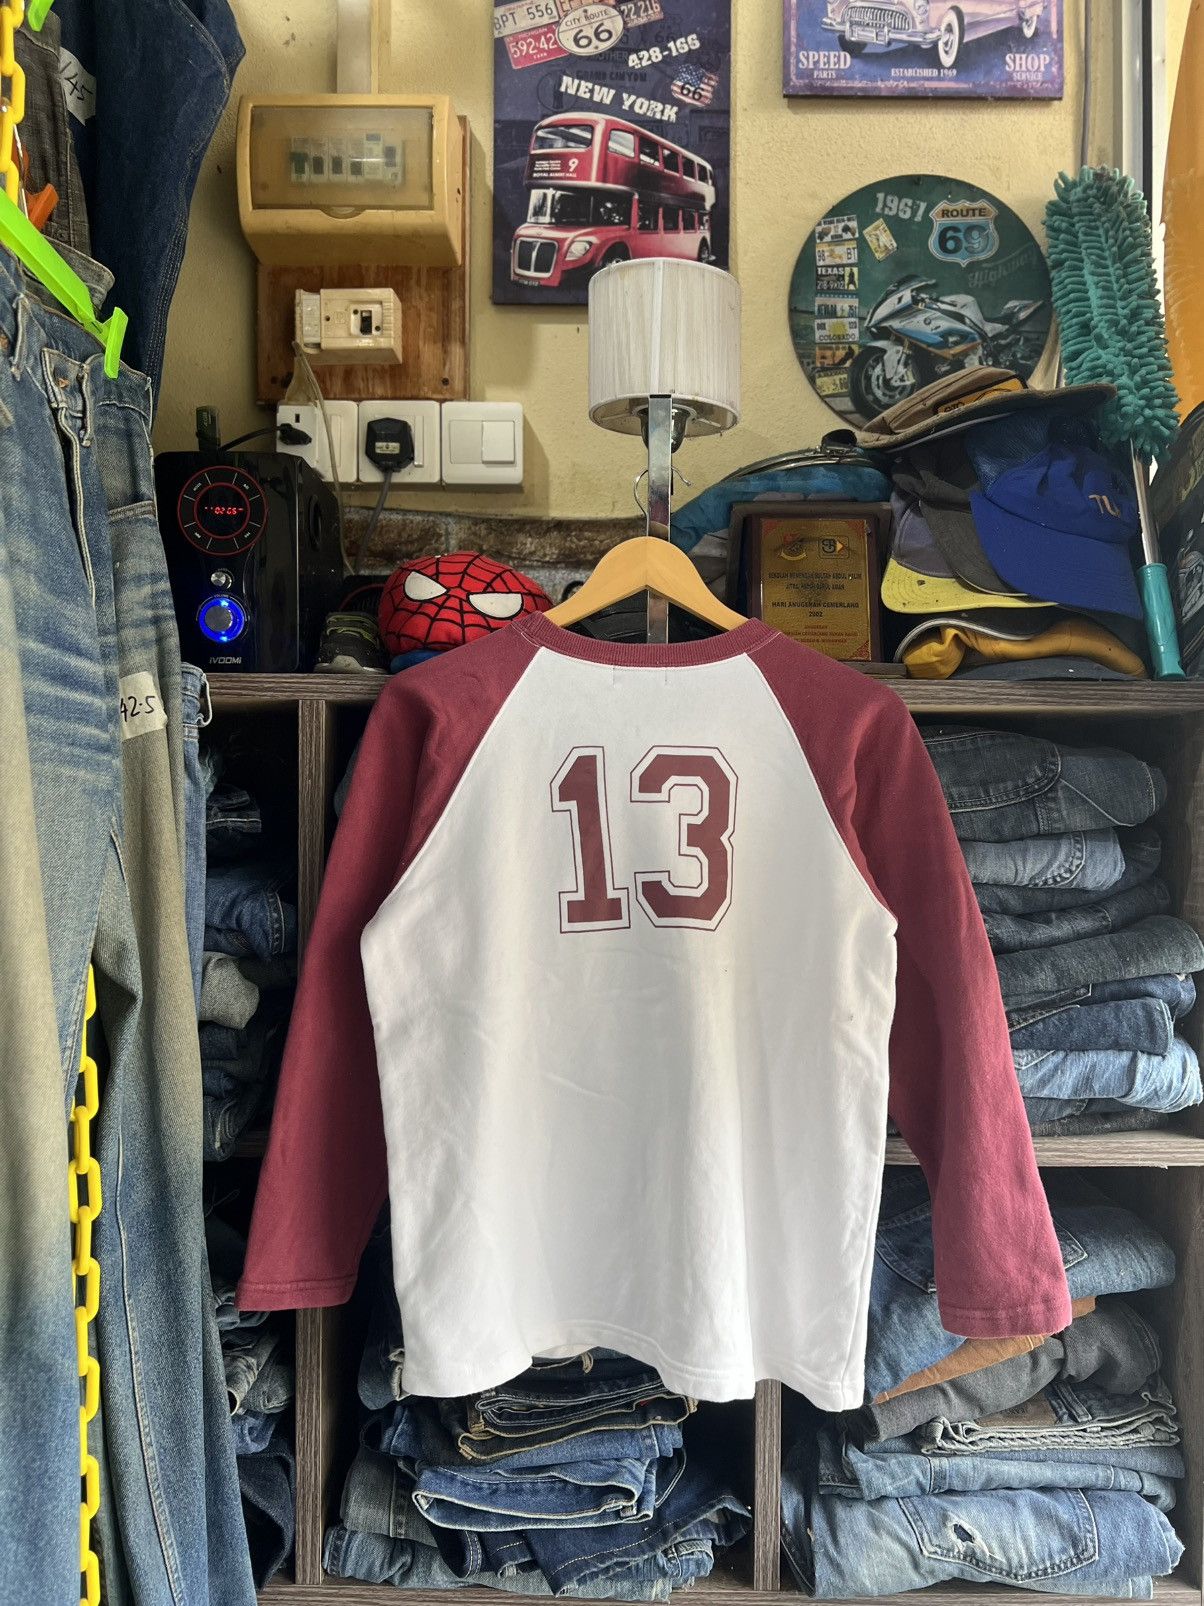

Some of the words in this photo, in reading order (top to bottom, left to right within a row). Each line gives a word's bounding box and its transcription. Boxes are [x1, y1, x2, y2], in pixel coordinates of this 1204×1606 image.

[527, 3, 553, 20] 556
[565, 17, 581, 28] CITY
[585, 9, 608, 22] ROUTE
[573, 22, 613, 49] 66
[628, 33, 700, 69] 428-166
[799, 51, 851, 69] SPEED
[1005, 53, 1050, 71] SHOP
[813, 70, 836, 79] PARTS
[891, 68, 938, 77] ESTABLISHED
[560, 75, 616, 105] NEW
[622, 92, 679, 123] YORK
[680, 82, 704, 101] 66
[568, 158, 579, 172] 9
[875, 192, 927, 222] 1967
[941, 207, 987, 219] ROUTE
[817, 266, 845, 276] TEXAS
[550, 745, 738, 934] 13
